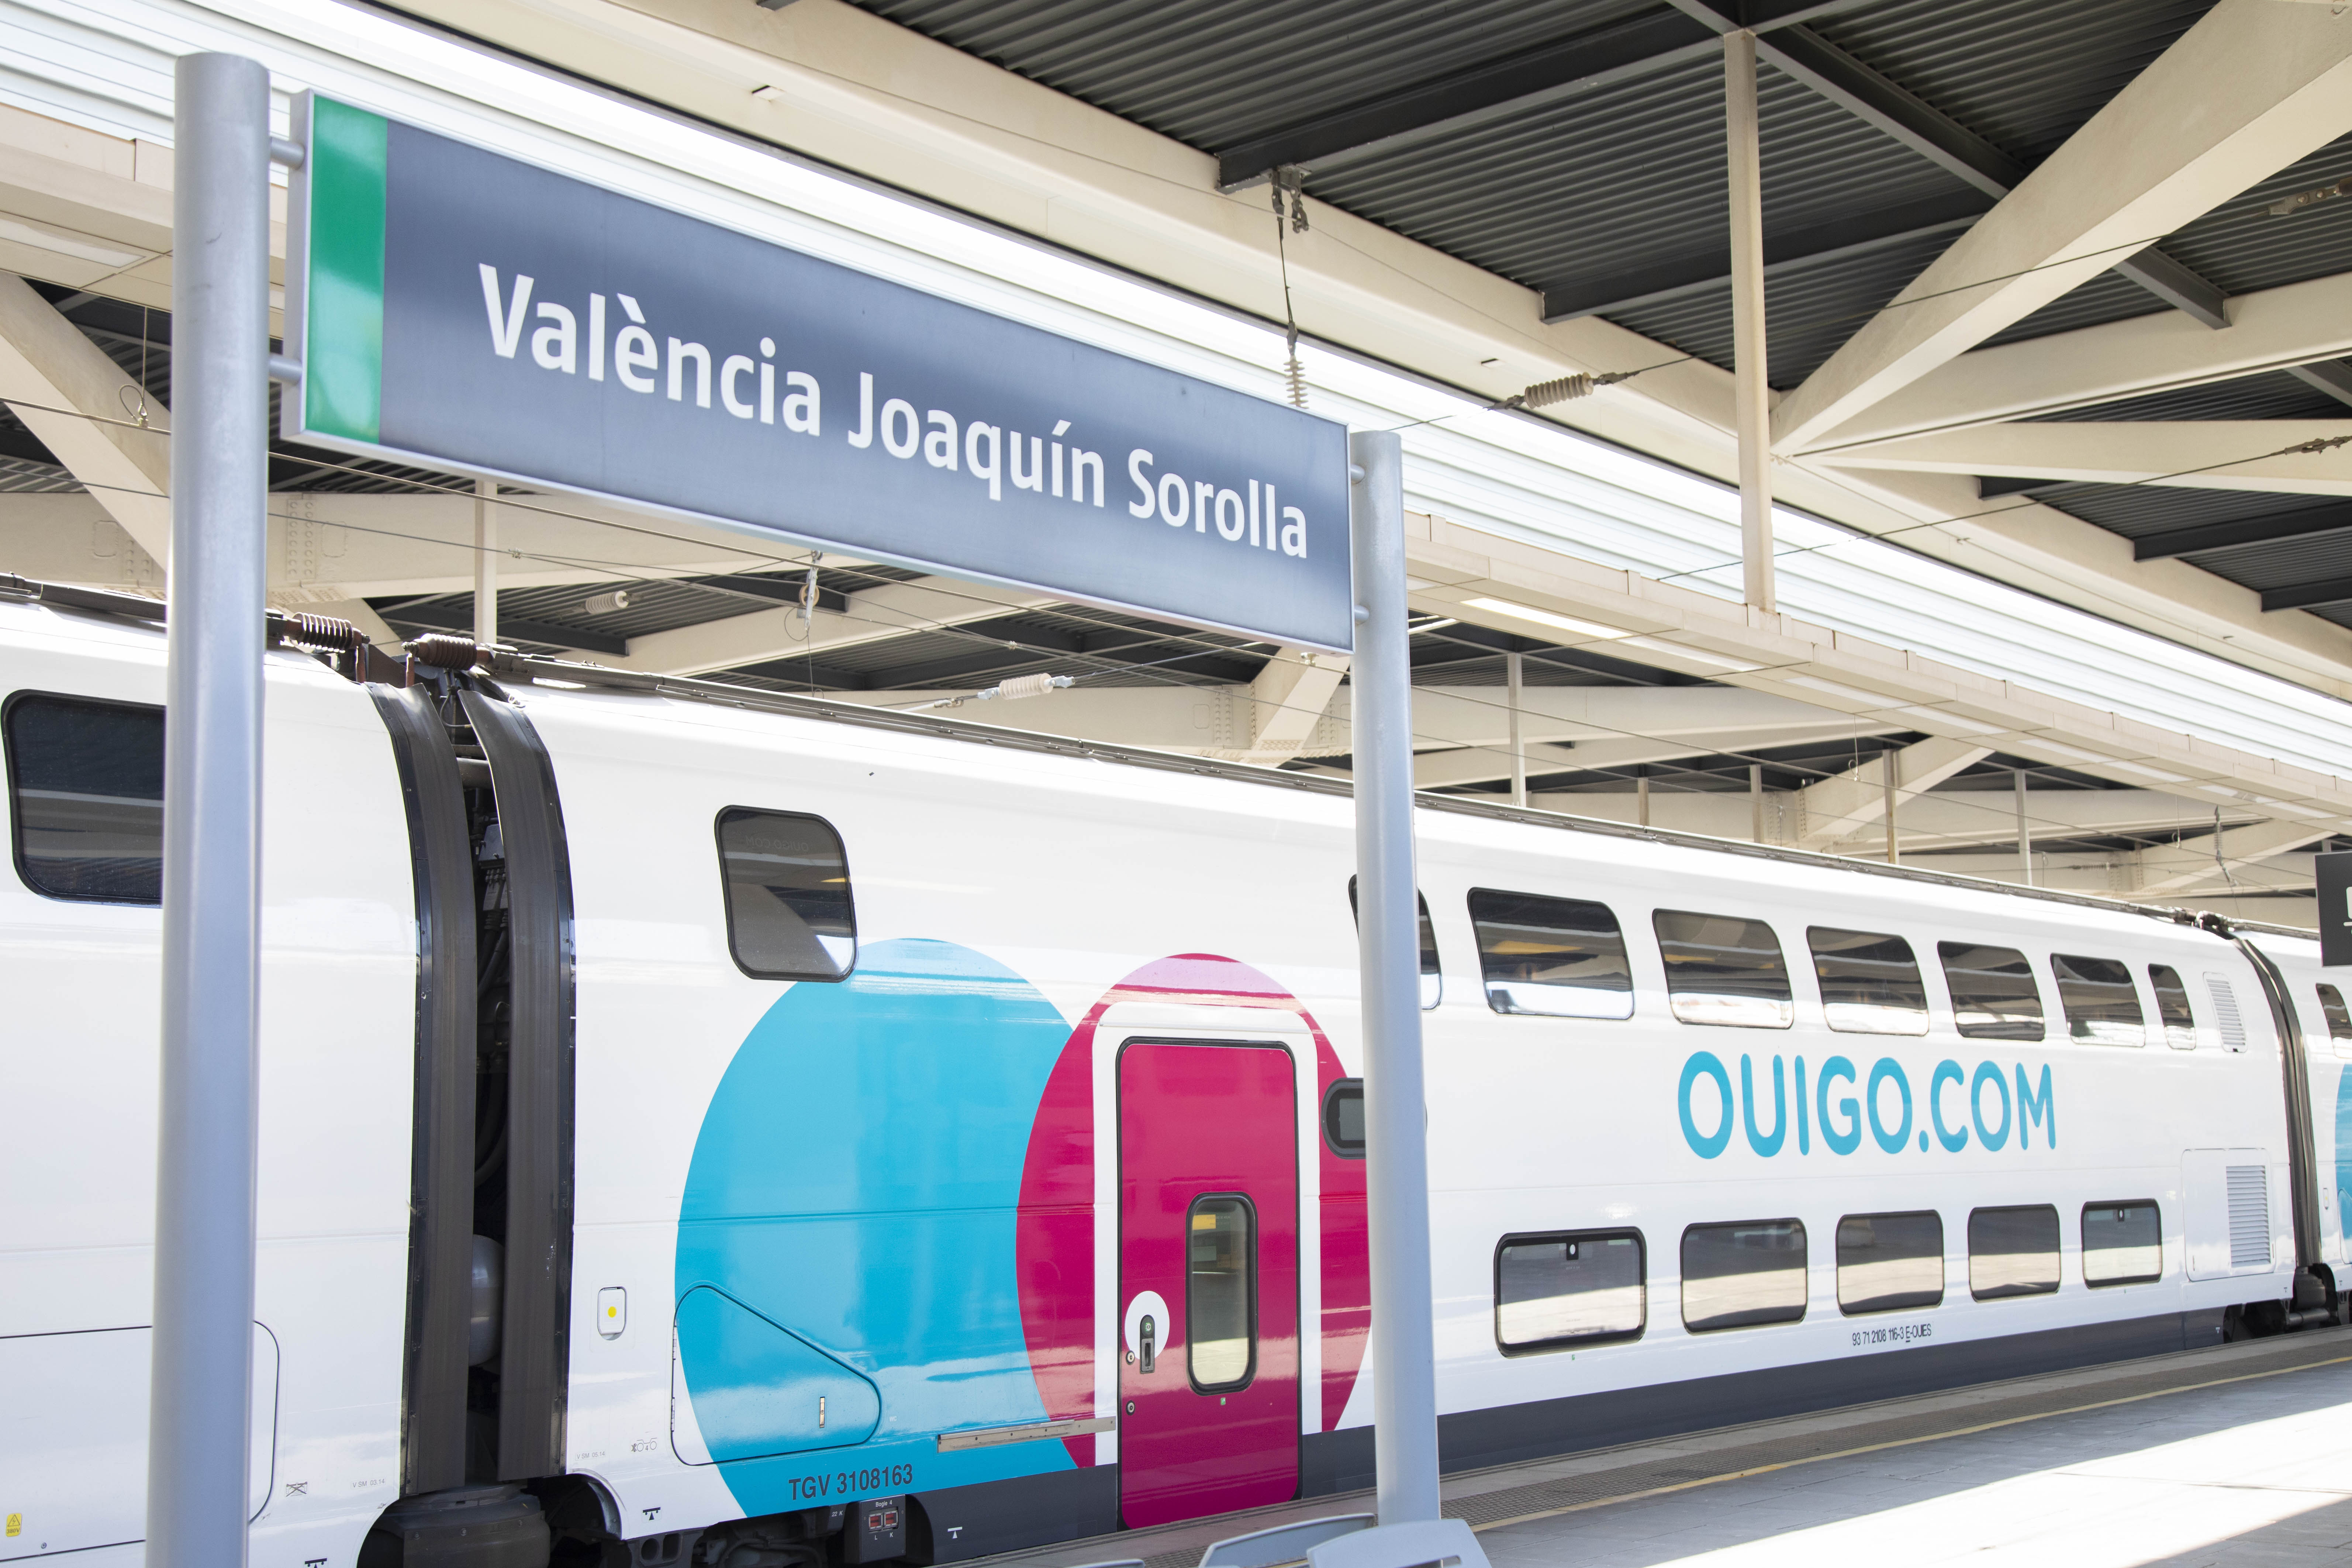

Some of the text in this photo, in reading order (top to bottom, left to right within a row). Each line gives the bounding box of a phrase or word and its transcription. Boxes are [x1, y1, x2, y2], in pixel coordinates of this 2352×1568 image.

[480, 263, 1307, 558] València Joaquín Sorolla
[1678, 1051, 2056, 1160] OUIGO.COM
[1852, 1333, 1861, 1346] 93
[1863, 1332, 1869, 1344] 71
[1872, 1329, 1886, 1343] 2108
[1889, 1327, 1904, 1340] 116-3
[788, 1464, 913, 1500] TGV 3108163
